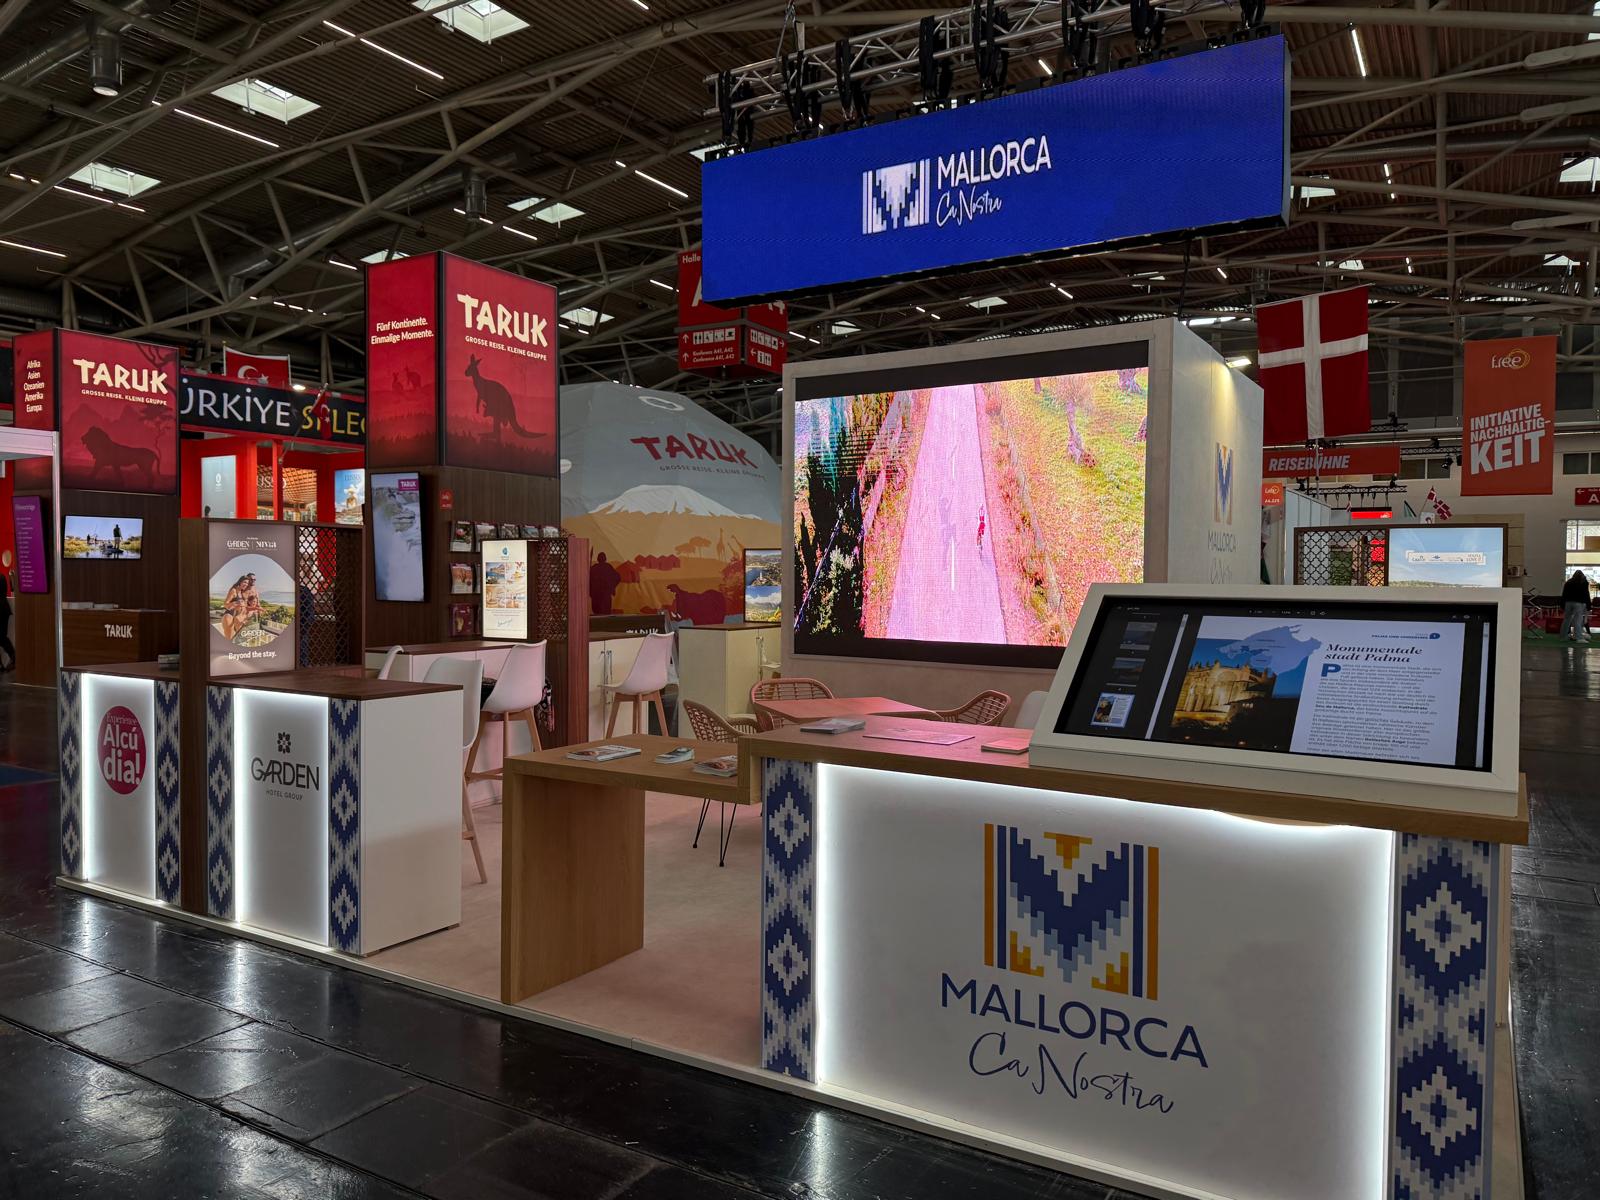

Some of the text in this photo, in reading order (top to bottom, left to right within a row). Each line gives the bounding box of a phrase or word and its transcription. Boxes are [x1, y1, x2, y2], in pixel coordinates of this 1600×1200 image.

[937, 135, 1052, 190] MALLORCA
[936, 185, 1002, 227] Ca Nostra
[376, 317, 428, 332] Fünf Kontinente.
[457, 294, 548, 348] TARUK
[371, 330, 434, 345] Einmalige Momente.
[465, 335, 547, 361] GROSSE REISE. KLEINE GRUPPE
[27, 360, 41, 369] Afrika
[27, 371, 41, 380] Asien
[73, 358, 168, 395] TARUK
[23, 381, 45, 391] Ozeanien
[24, 391, 44, 402] Amerika
[81, 389, 105, 397] GROSSE
[125, 394, 144, 403] KLEINE
[145, 397, 167, 406] GRUPPE
[26, 403, 43, 413] Europa
[302, 404, 366, 436] SLE
[1470, 403, 1541, 431] INITIATIVE
[1470, 417, 1551, 443] NACHHALTIG-
[630, 432, 759, 469] TARUK
[1268, 453, 1350, 472] REISEBÜHNE
[1470, 429, 1546, 475] KEIT
[104, 624, 133, 638] TARUK
[228, 651, 277, 661] Beyond the stay.
[1324, 652, 1410, 663] stadt Palma
[1326, 644, 1422, 655] Monumentale
[103, 724, 138, 751] Alcú
[103, 749, 141, 785] dia!
[251, 757, 320, 791] GARDEN
[265, 789, 303, 800] HOTEL GROUP
[941, 972, 1208, 1069] MALLORCA
[969, 1032, 1174, 1114] Ca Nostra
